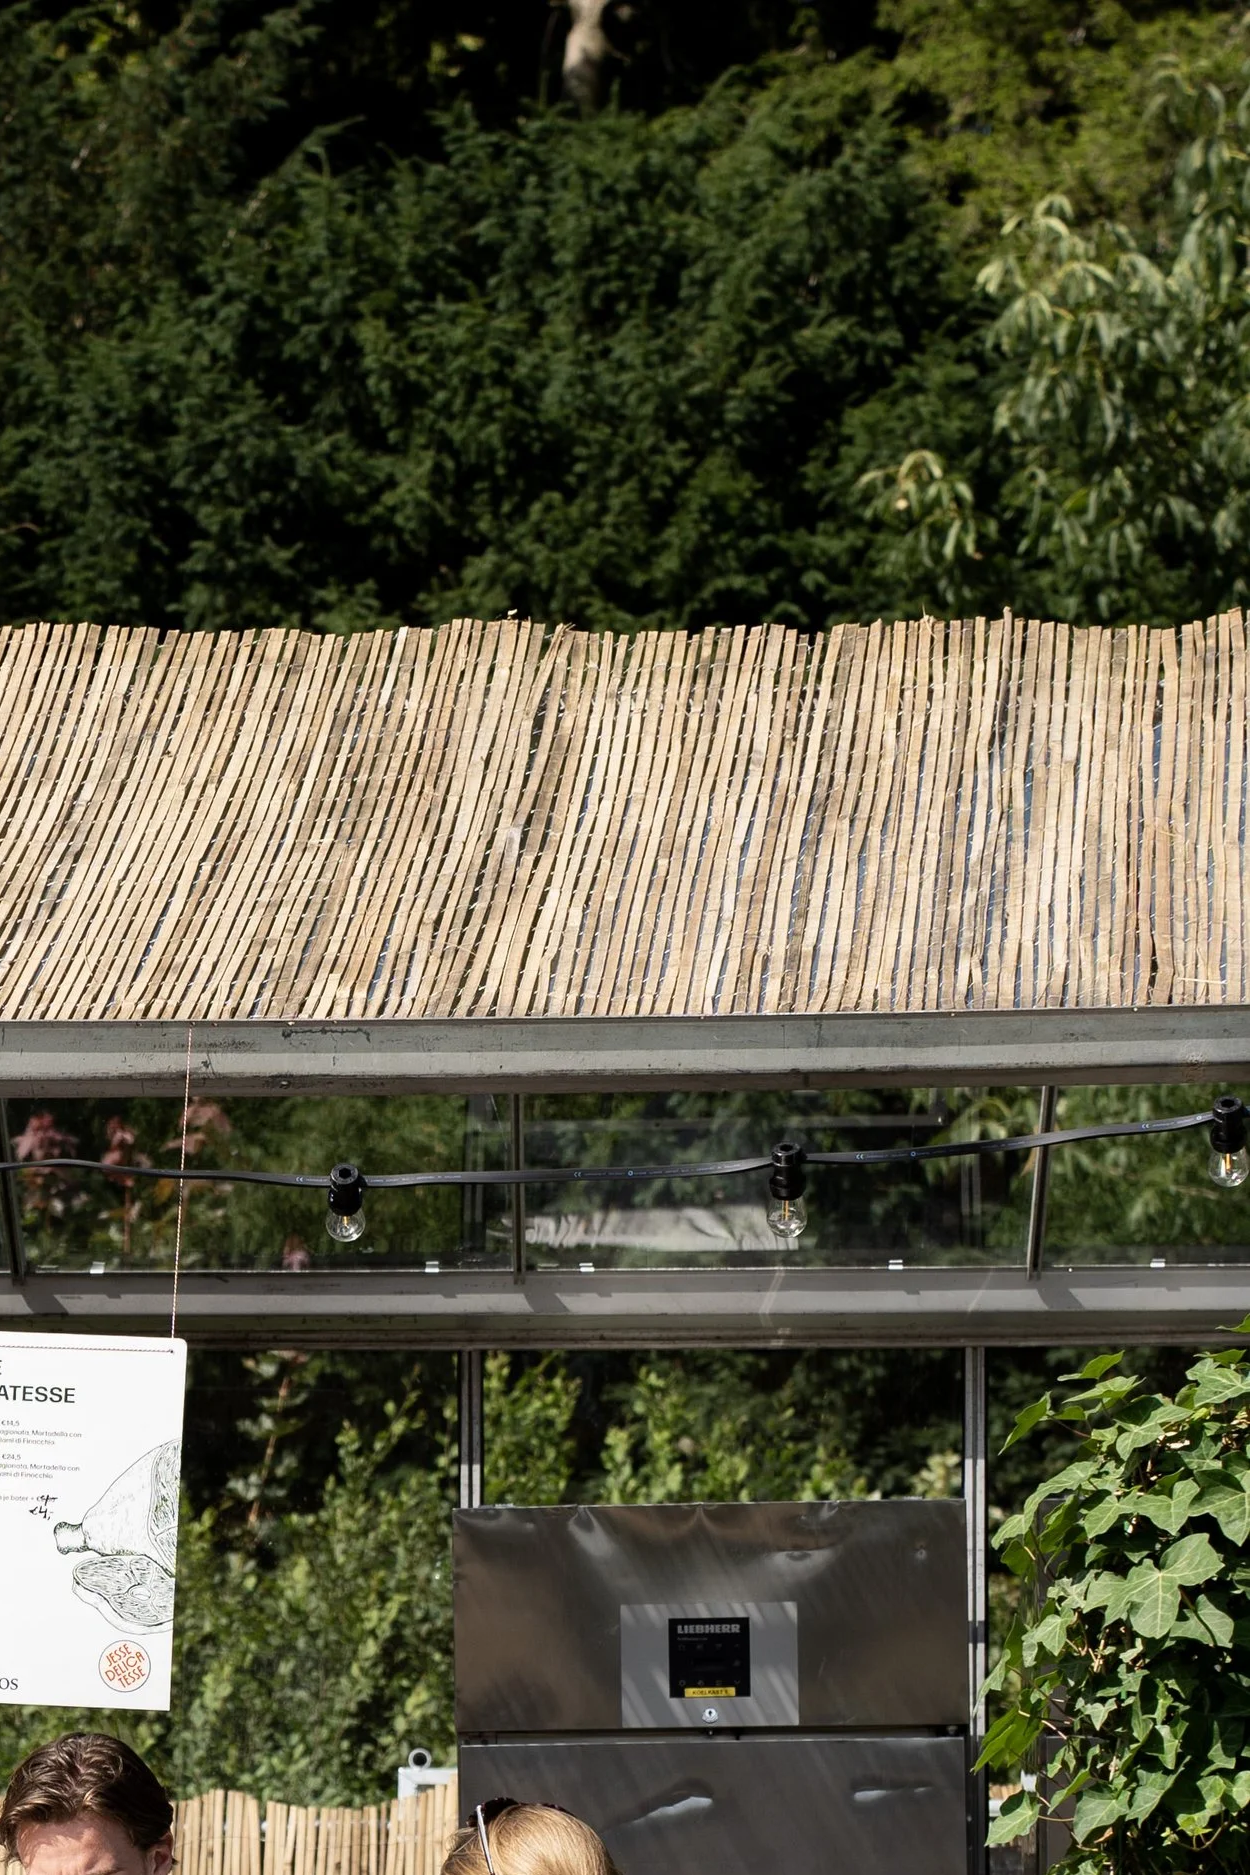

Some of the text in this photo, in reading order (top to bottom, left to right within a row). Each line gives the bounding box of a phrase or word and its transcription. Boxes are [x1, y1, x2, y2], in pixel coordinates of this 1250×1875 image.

[32, 1430, 68, 1438] Mortadella
[677, 1624, 741, 1634] LIEBHERR
[105, 1651, 145, 1681] DELICA
[106, 1643, 132, 1667] JESSE
[118, 1665, 145, 1688] TESSE
